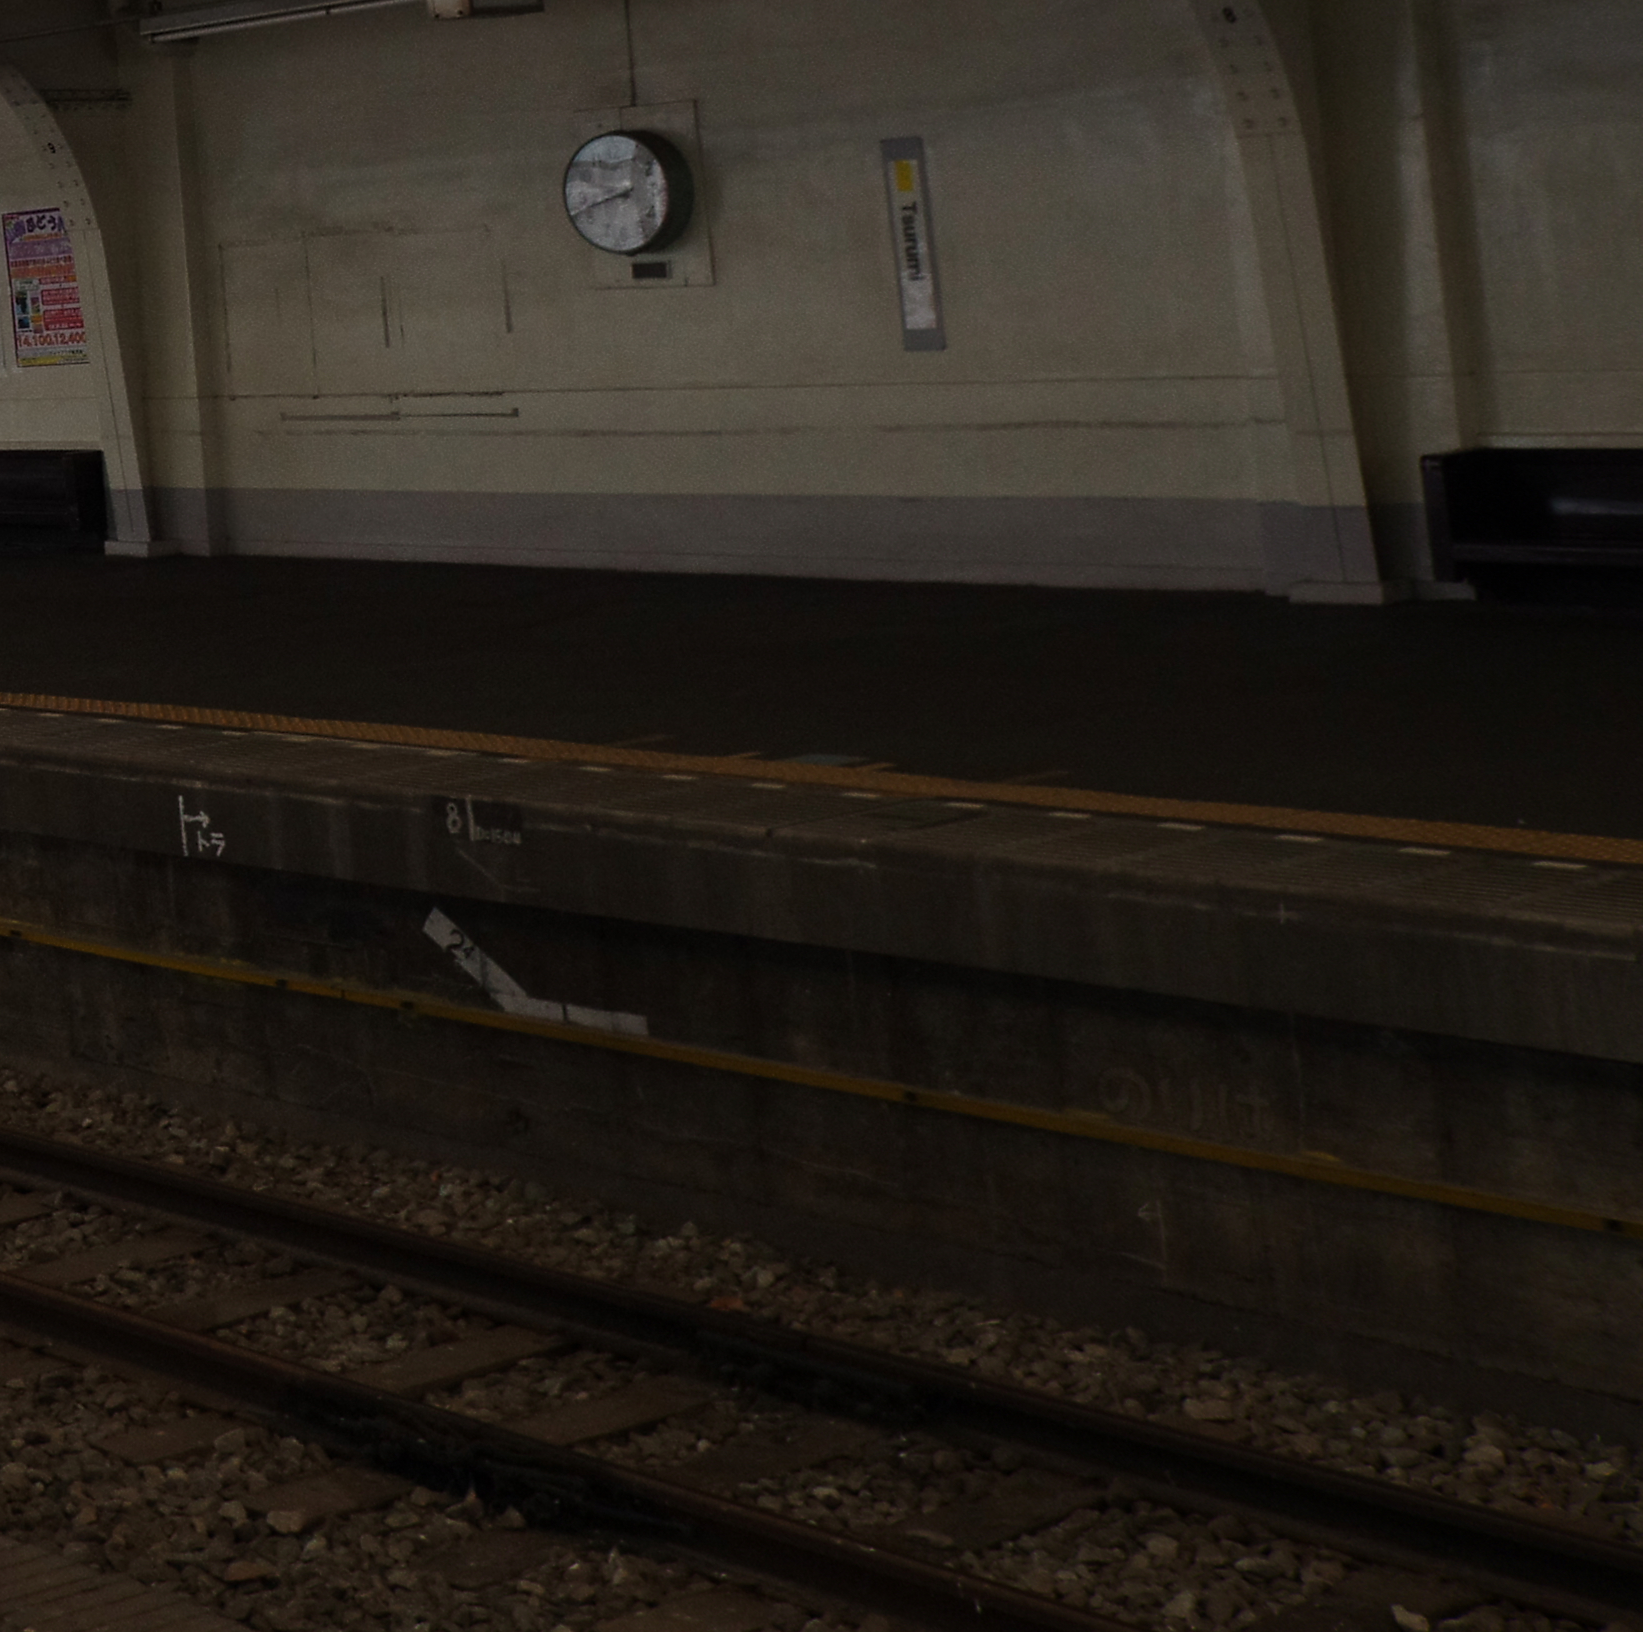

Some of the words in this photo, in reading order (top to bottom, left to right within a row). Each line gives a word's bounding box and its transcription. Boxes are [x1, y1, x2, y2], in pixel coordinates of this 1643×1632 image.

[900, 200, 925, 282] Tsurumi
[446, 802, 463, 834] 8
[197, 830, 226, 857] トラ
